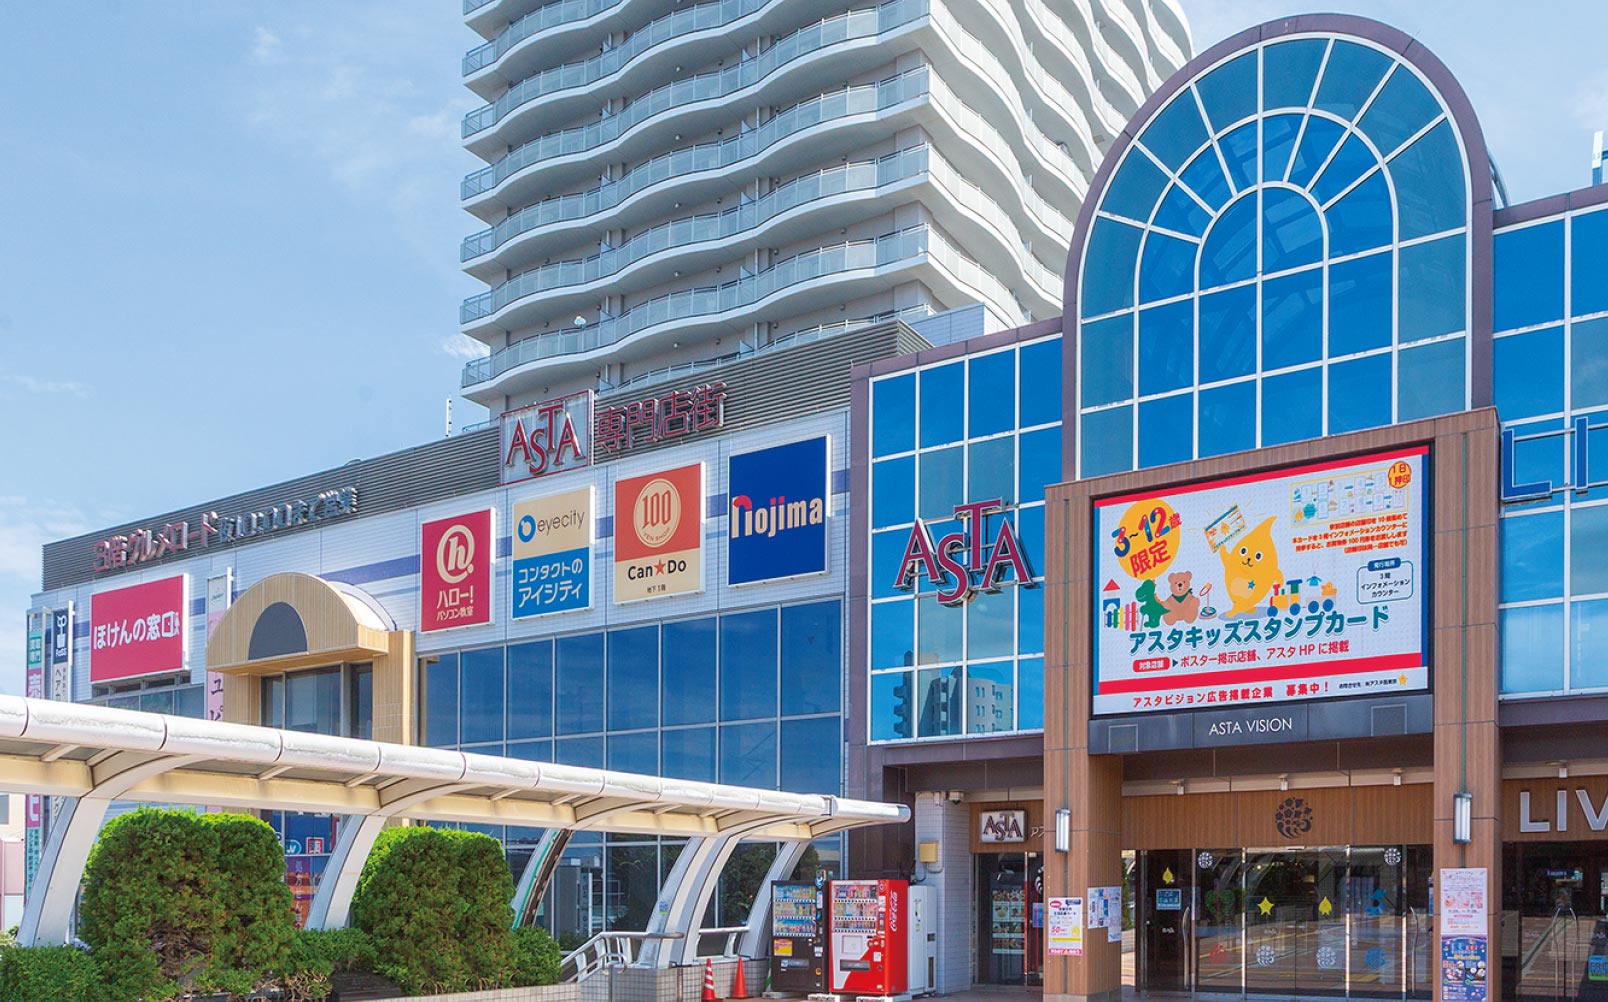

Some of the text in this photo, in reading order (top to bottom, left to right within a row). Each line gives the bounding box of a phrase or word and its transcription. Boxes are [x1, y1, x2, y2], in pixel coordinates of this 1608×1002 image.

[596, 383, 727, 450] 専門店街
[505, 402, 585, 475] ASTA
[537, 510, 585, 536] eyecity
[642, 490, 671, 529] 100
[731, 495, 823, 539] nojima
[893, 496, 1034, 604] ASTA
[1129, 539, 1171, 578] 限定
[518, 557, 583, 584] コンタクトの
[1361, 579, 1411, 590] インフォメーション
[518, 580, 583, 609] アイシティ
[1372, 590, 1399, 598] カウンター
[436, 605, 474, 621] パソコン教室
[93, 610, 176, 650] ほけんの窓口
[1129, 605, 1389, 654] アスタキッズスタンプカード
[1132, 686, 1273, 708] アスタビジョン広告掲載企業
[1208, 717, 1292, 736] ASTA VISION
[983, 812, 1023, 841] ASTA
